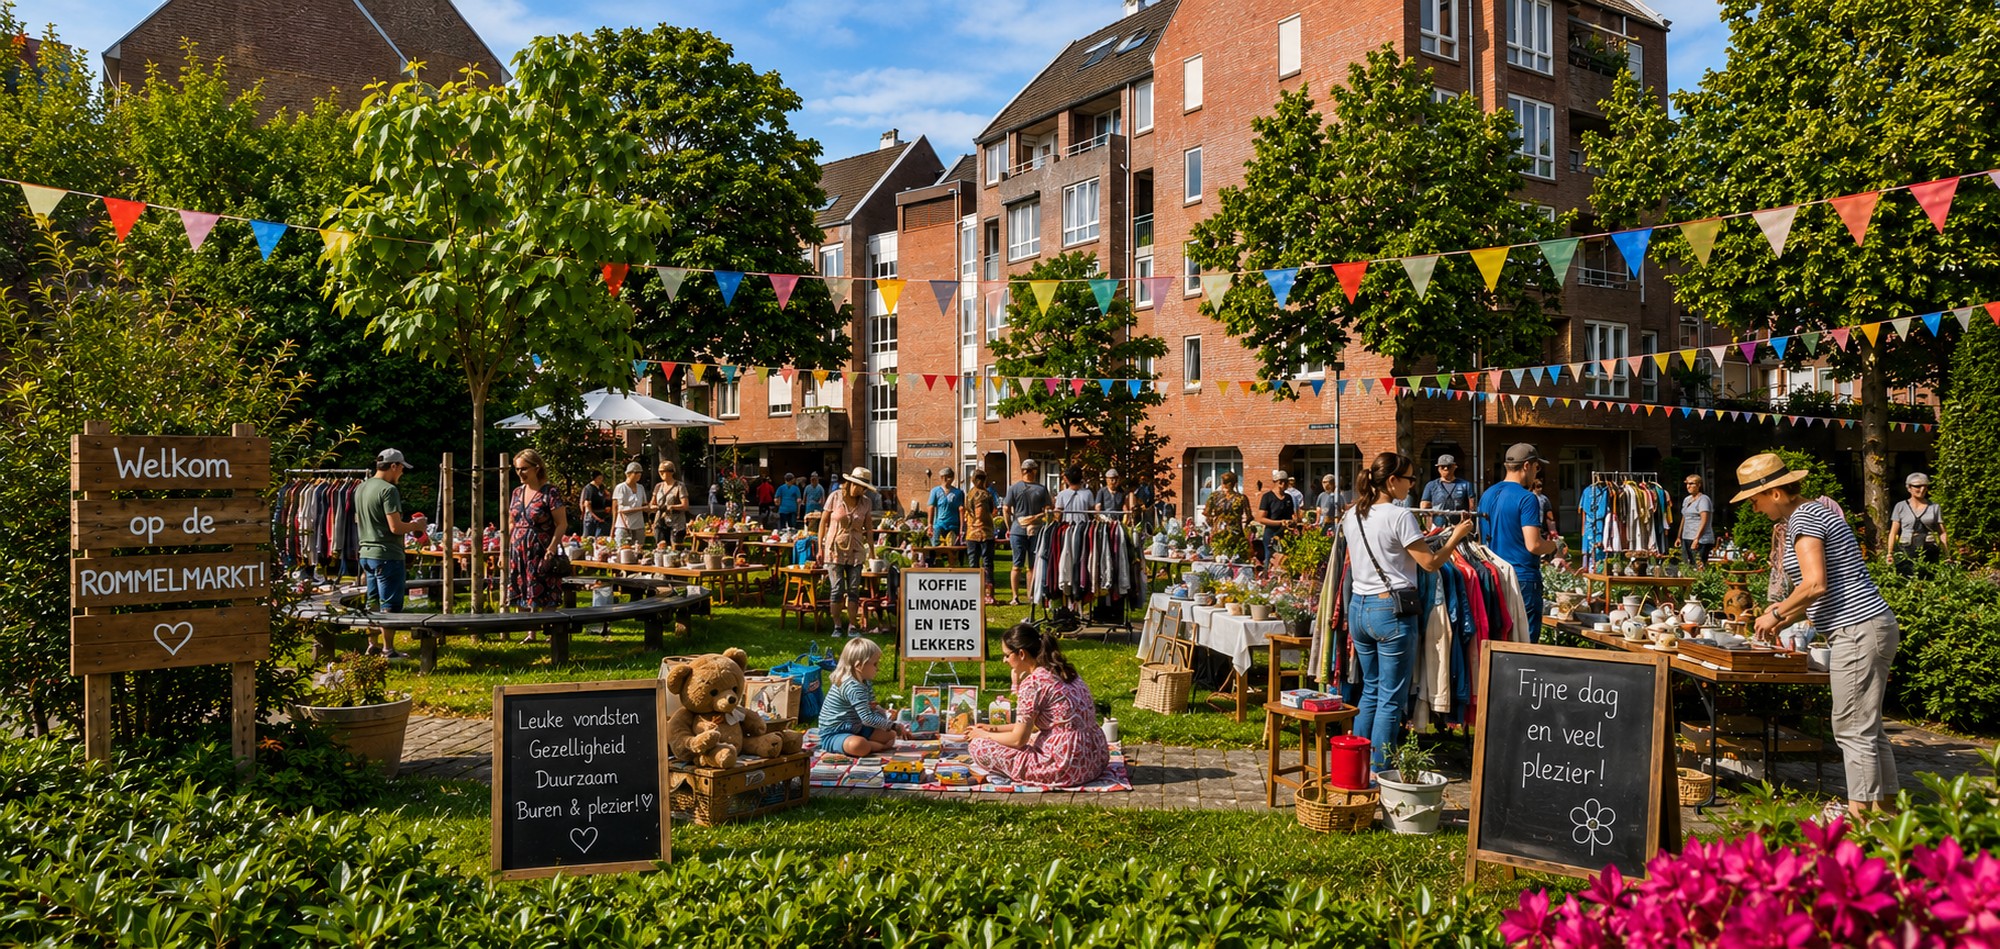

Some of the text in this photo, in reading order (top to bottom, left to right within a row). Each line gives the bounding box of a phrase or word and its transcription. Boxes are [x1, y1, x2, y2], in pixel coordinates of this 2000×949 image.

[113, 447, 232, 479] Welkom
[130, 506, 216, 544] op de
[80, 562, 265, 596] ROMMELMARKT!
[918, 579, 966, 591] KOFFIE
[908, 599, 976, 611] LIMONADE
[914, 618, 970, 631] EN IETS
[911, 638, 975, 651] LEKKERS
[1518, 668, 1619, 719] Fijne dag
[518, 705, 640, 730] Leuke vondsten
[1527, 721, 1605, 749] en veel
[529, 735, 626, 764] Gezelligheid
[535, 769, 618, 789] Duurzaam
[1522, 752, 1606, 789] plezier!
[516, 794, 639, 822] Buren & plezier!
